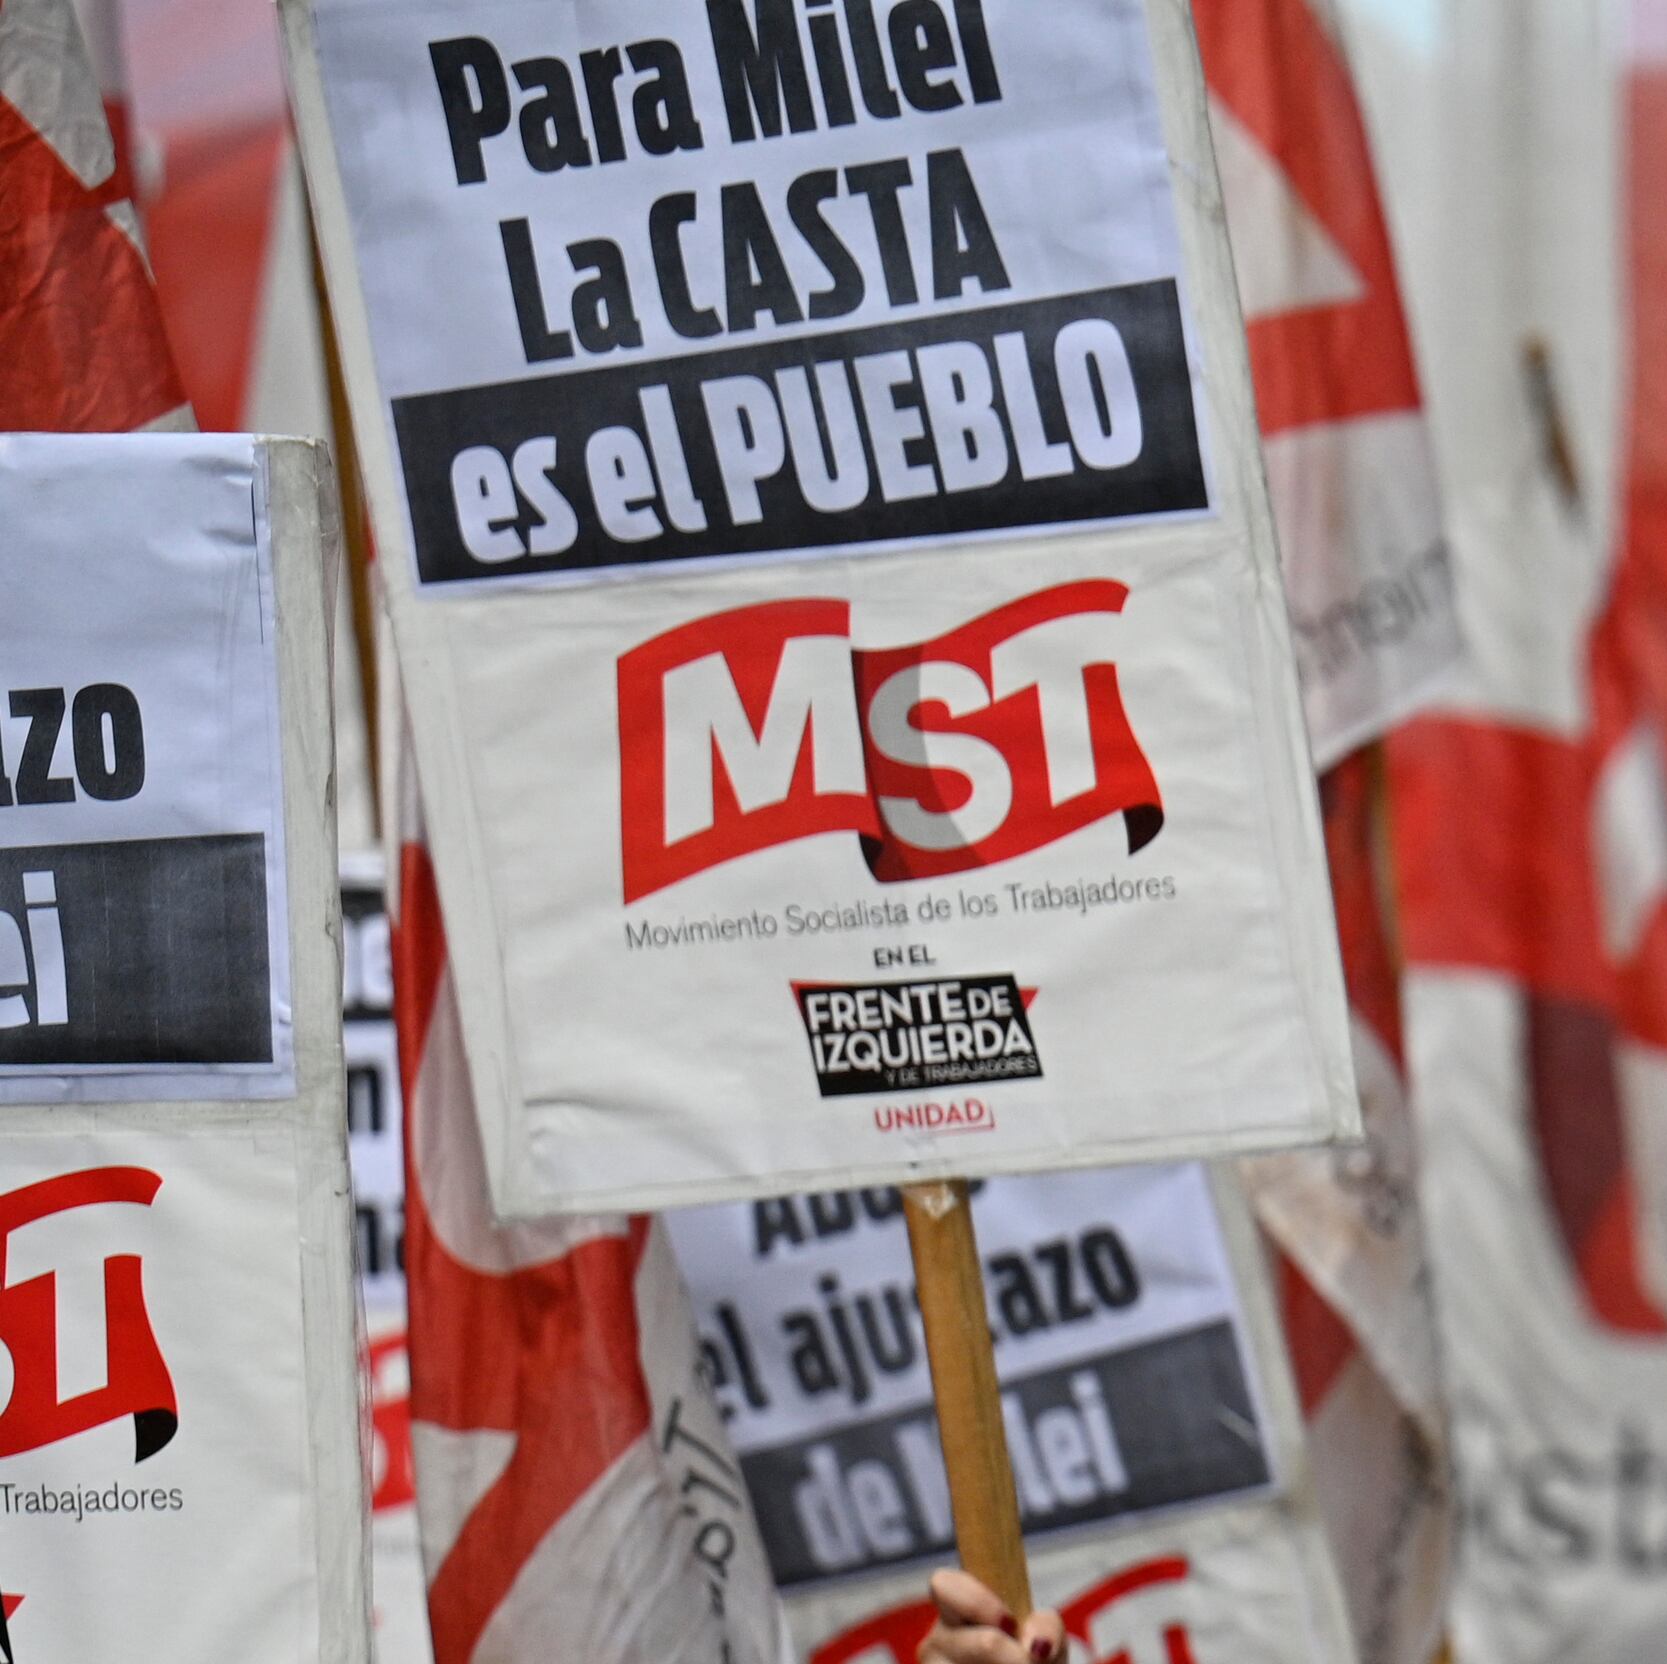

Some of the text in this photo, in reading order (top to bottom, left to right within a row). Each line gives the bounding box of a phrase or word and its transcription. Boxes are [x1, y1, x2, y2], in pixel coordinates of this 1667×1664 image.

[429, 0, 1003, 187] Para Milei
[499, 148, 1011, 364] La CASTA
[450, 318, 1144, 564] es el PUEBLO
[663, 610, 1124, 852] MST
[625, 875, 1176, 949] Movimiento Socialista de los Trabajadores
[873, 944, 936, 968] EN EL
[805, 982, 1012, 1033] FRENTE DE
[813, 1018, 1032, 1074] IZQUIERDA
[924, 1056, 1037, 1082] TRABAJADORES
[874, 1099, 983, 1132] UNIDAD
[781, 1223, 1142, 1405] ajuazo
[0, 1482, 183, 1522] Trabajadores
[795, 1442, 913, 1569] de
